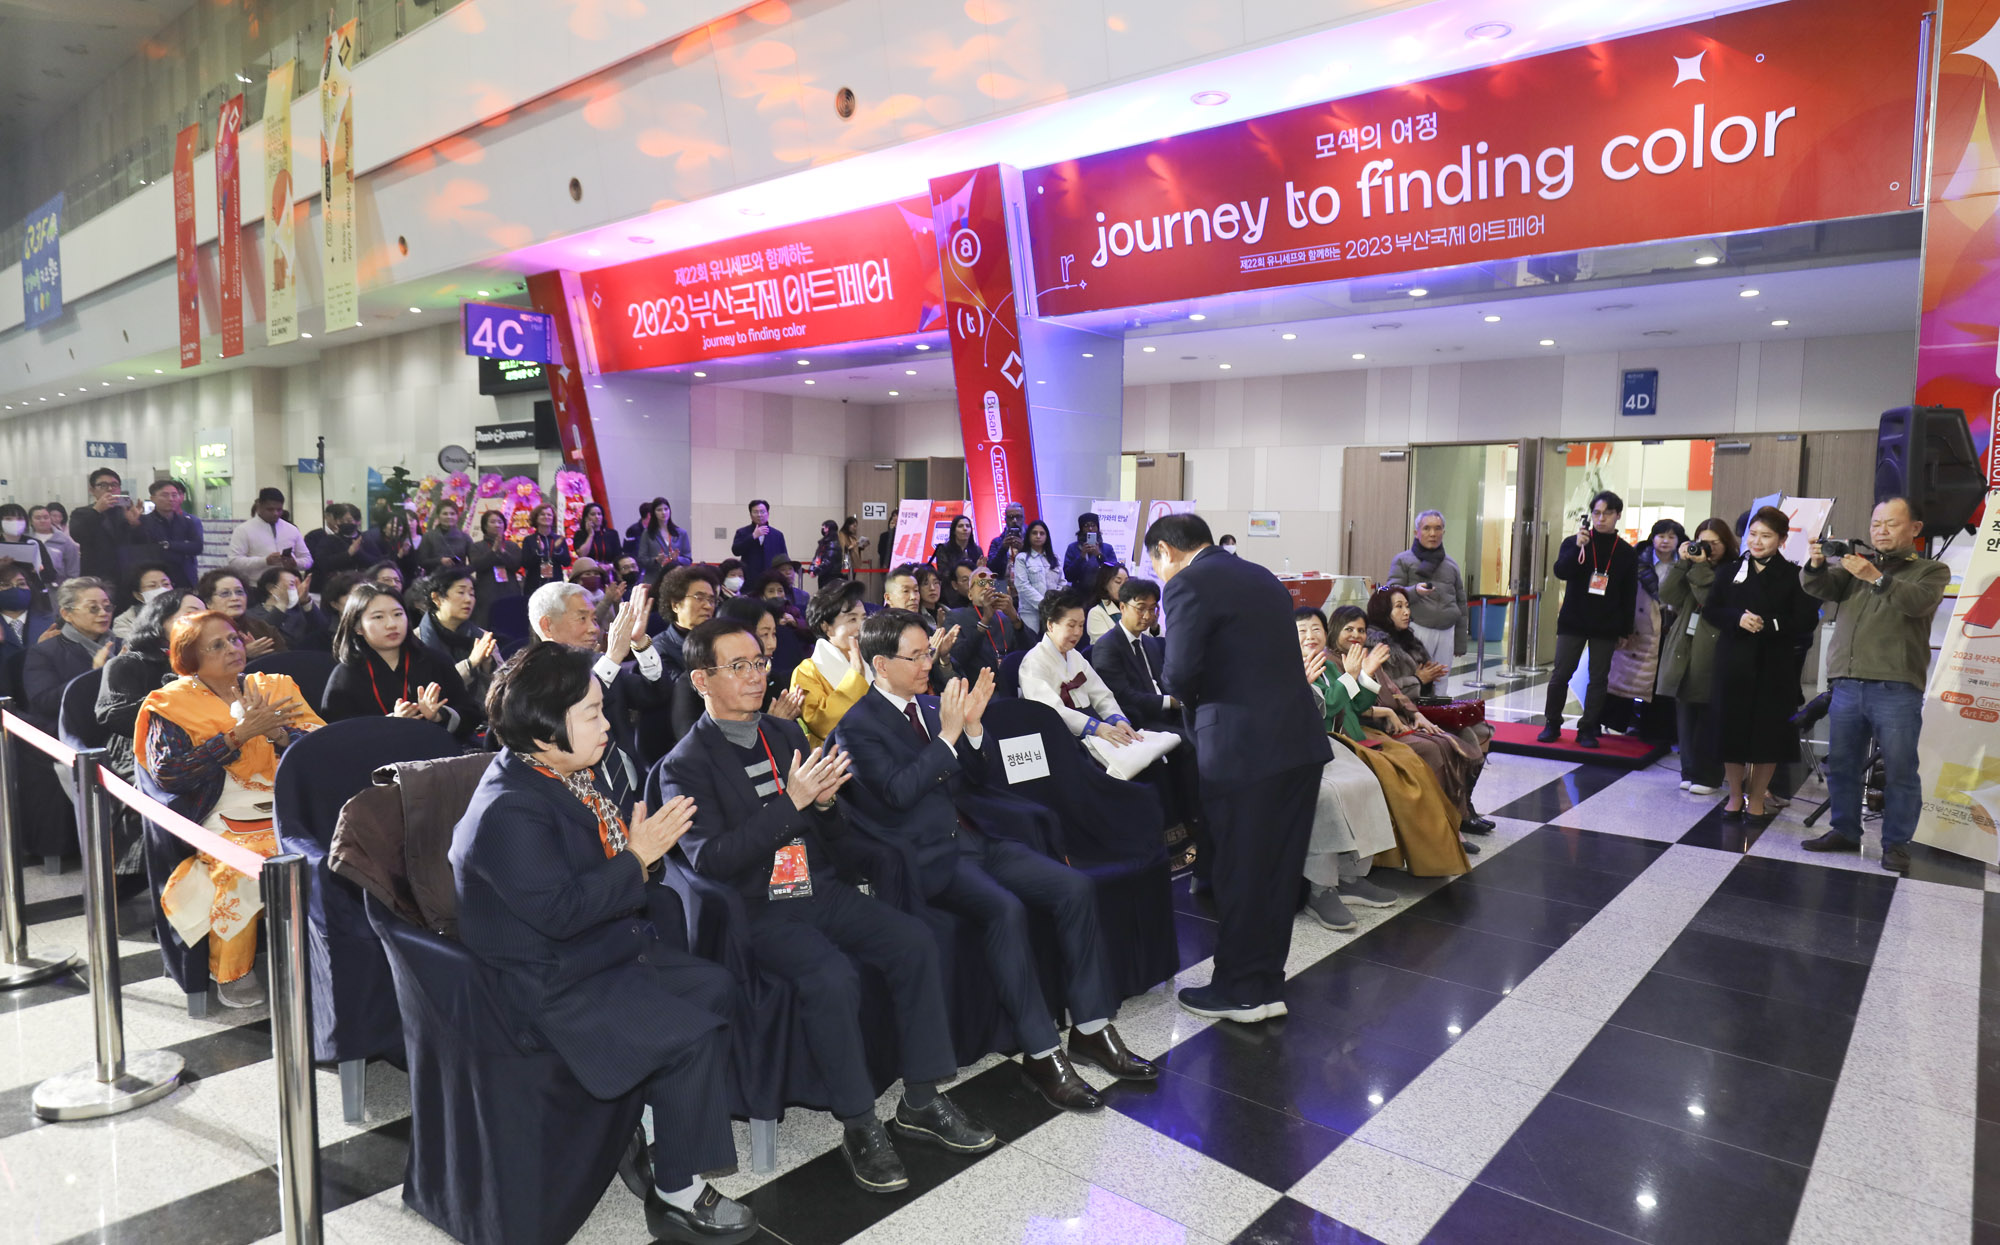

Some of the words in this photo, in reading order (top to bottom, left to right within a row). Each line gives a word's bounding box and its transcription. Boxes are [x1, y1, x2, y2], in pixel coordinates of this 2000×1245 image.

[1315, 123, 1382, 160] 모색의
[1390, 111, 1439, 146] 여정
[1091, 197, 1269, 268] journey
[1286, 181, 1340, 229] to
[1357, 141, 1575, 218] finding
[1600, 103, 1796, 181] color
[1240, 257, 1265, 271] 제22회
[1266, 251, 1306, 267] 유니세프와
[1307, 246, 1341, 262] 함께하는
[1345, 235, 1393, 260] 2023
[1394, 225, 1465, 253] 부산국제
[1469, 214, 1545, 244] 아트페어
[674, 264, 709, 286] 제22회
[709, 250, 764, 281] 유니세프와
[765, 242, 814, 271] 함께하는
[472, 317, 524, 357] 4C
[702, 330, 736, 350] journey
[736, 329, 747, 344] to
[748, 325, 781, 343] finding
[782, 322, 807, 338] color
[1625, 393, 1650, 410] 4D
[986, 396, 998, 437] Busan
[992, 452, 1008, 531] Internatio
[864, 505, 886, 517] 입구
[1952, 651, 1973, 661] 2023
[1943, 692, 1971, 704] Busan
[1981, 699, 2000, 709] Inte
[1962, 709, 1977, 718] Art
[1979, 711, 1996, 721] Fair
[1007, 750, 1033, 767] 정천식
[1034, 750, 1042, 761] 님
[1922, 801, 1936, 812] 23
